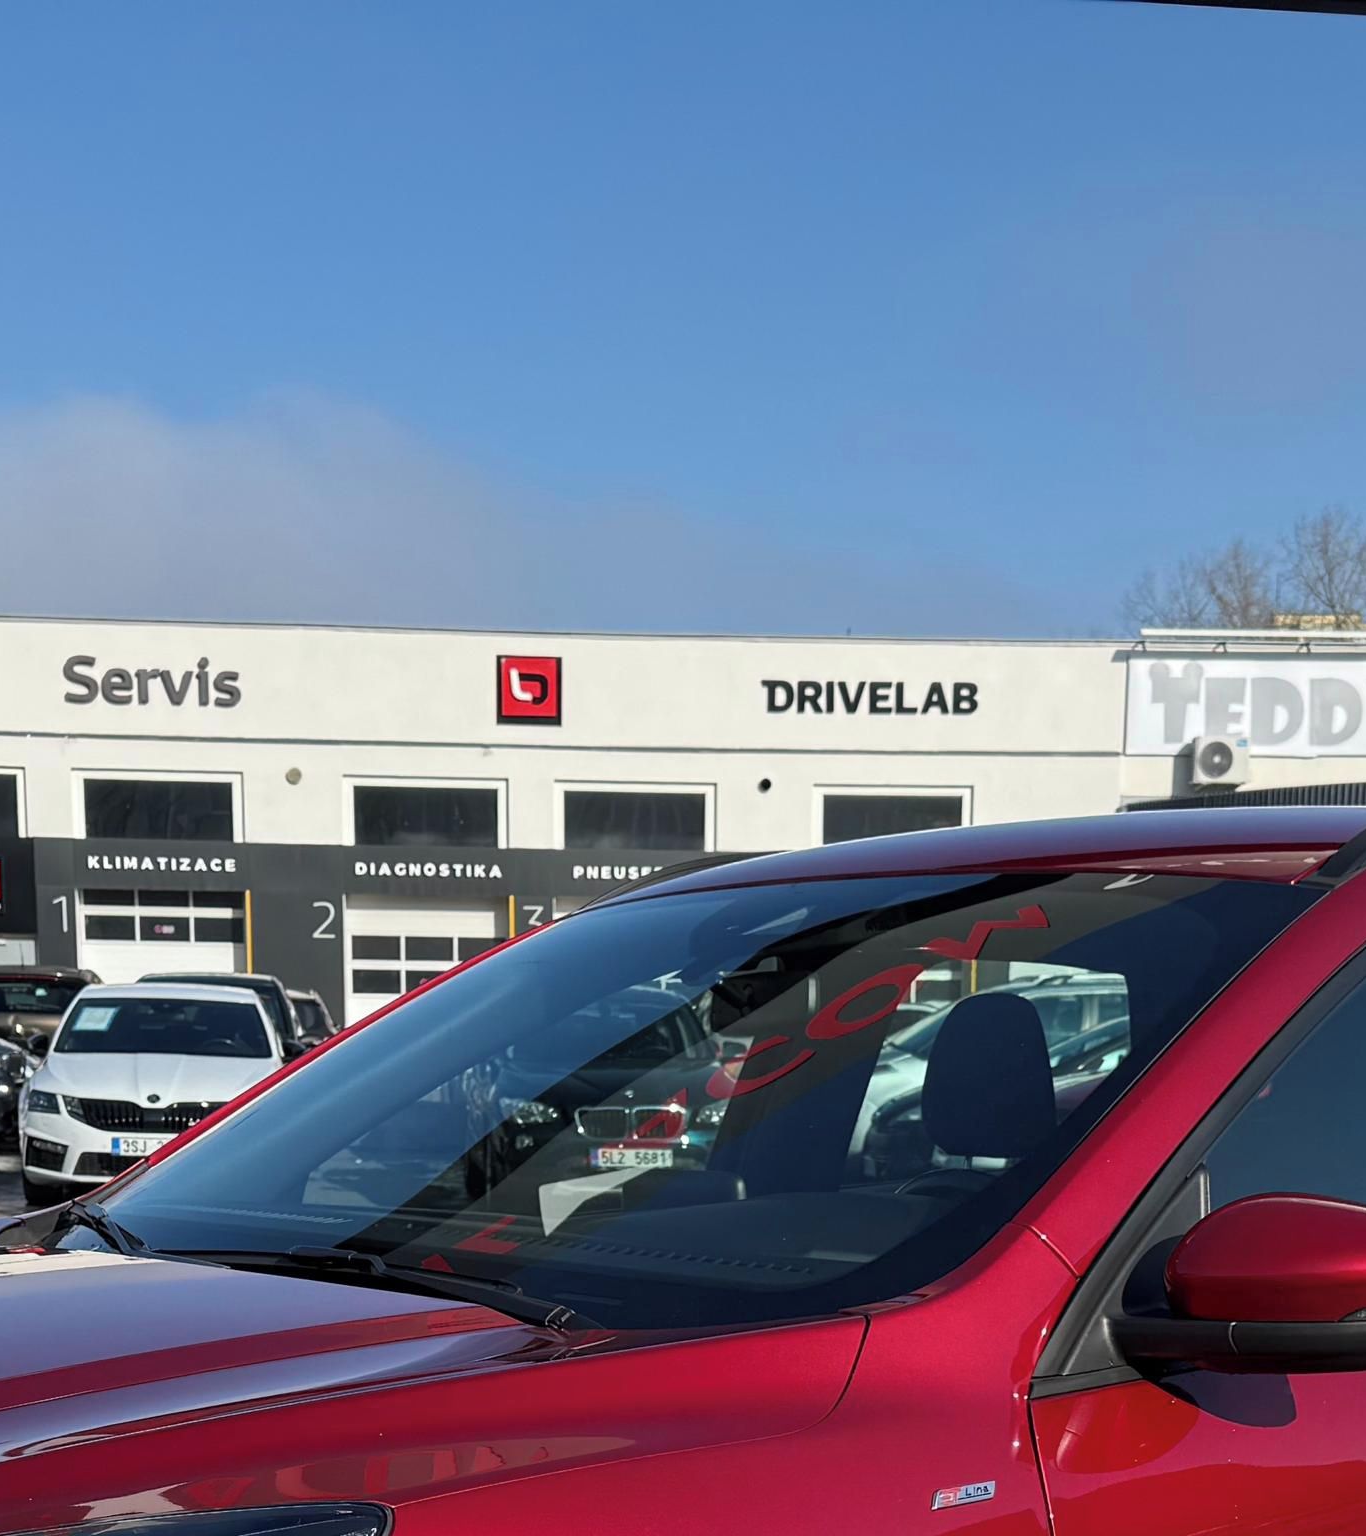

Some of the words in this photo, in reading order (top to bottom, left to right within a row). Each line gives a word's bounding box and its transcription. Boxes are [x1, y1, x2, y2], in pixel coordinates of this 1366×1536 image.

[63, 655, 243, 708] Servis
[761, 680, 979, 714] DRIVELAB
[87, 855, 236, 873] KLIMATIZACE
[354, 861, 503, 879] DIAGNOSTIKA
[52, 895, 68, 933] 1
[312, 901, 336, 939] 2
[122, 1140, 147, 1153] 3SJ
[601, 1151, 626, 1165] 5L2
